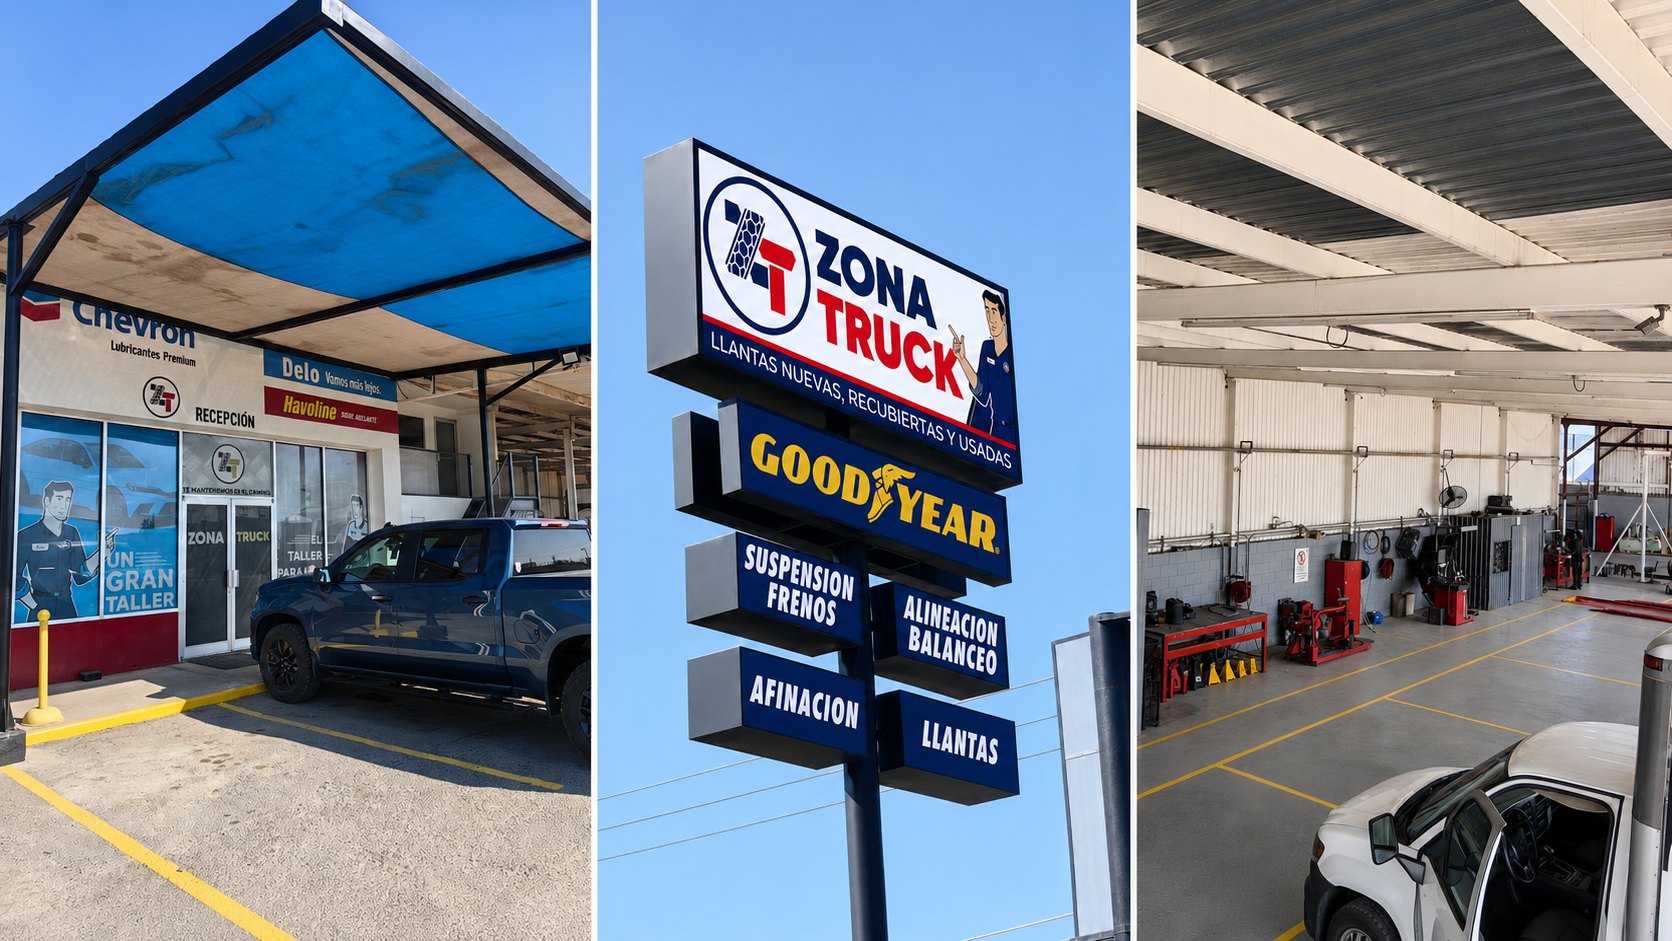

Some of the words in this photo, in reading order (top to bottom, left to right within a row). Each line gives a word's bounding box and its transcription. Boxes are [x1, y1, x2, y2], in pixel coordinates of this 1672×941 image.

[815, 228, 938, 330] ZONA
[72, 301, 195, 349] Chevron
[816, 288, 964, 400] TRUCK
[111, 339, 160, 360] Lubricantes
[163, 351, 196, 368] Premium
[282, 356, 320, 384] Delo
[325, 371, 348, 388] Vamos
[349, 379, 364, 391] más
[195, 407, 255, 429] RECEPCIÓN
[283, 395, 337, 421] Havoline
[710, 331, 778, 374] LLANTAS
[781, 360, 845, 405] NUEVAS,
[848, 388, 944, 442] RECUBIERTAS
[946, 429, 956, 446] Y
[958, 433, 1012, 470] USADAS
[187, 531, 225, 545] ZONA
[236, 531, 270, 542] TRUCK
[287, 550, 323, 562] TALLER
[105, 568, 174, 592] GRAN
[106, 551, 134, 568] UN
[278, 567, 303, 578] PARA
[743, 543, 855, 602] SUSPENSION
[105, 591, 175, 613] TALLER
[766, 579, 837, 627] FRENOS
[903, 595, 998, 647] ALINEACION
[908, 625, 997, 676] BALANCEO
[749, 674, 860, 729] AFINACION
[921, 719, 999, 766] LLANTAS
